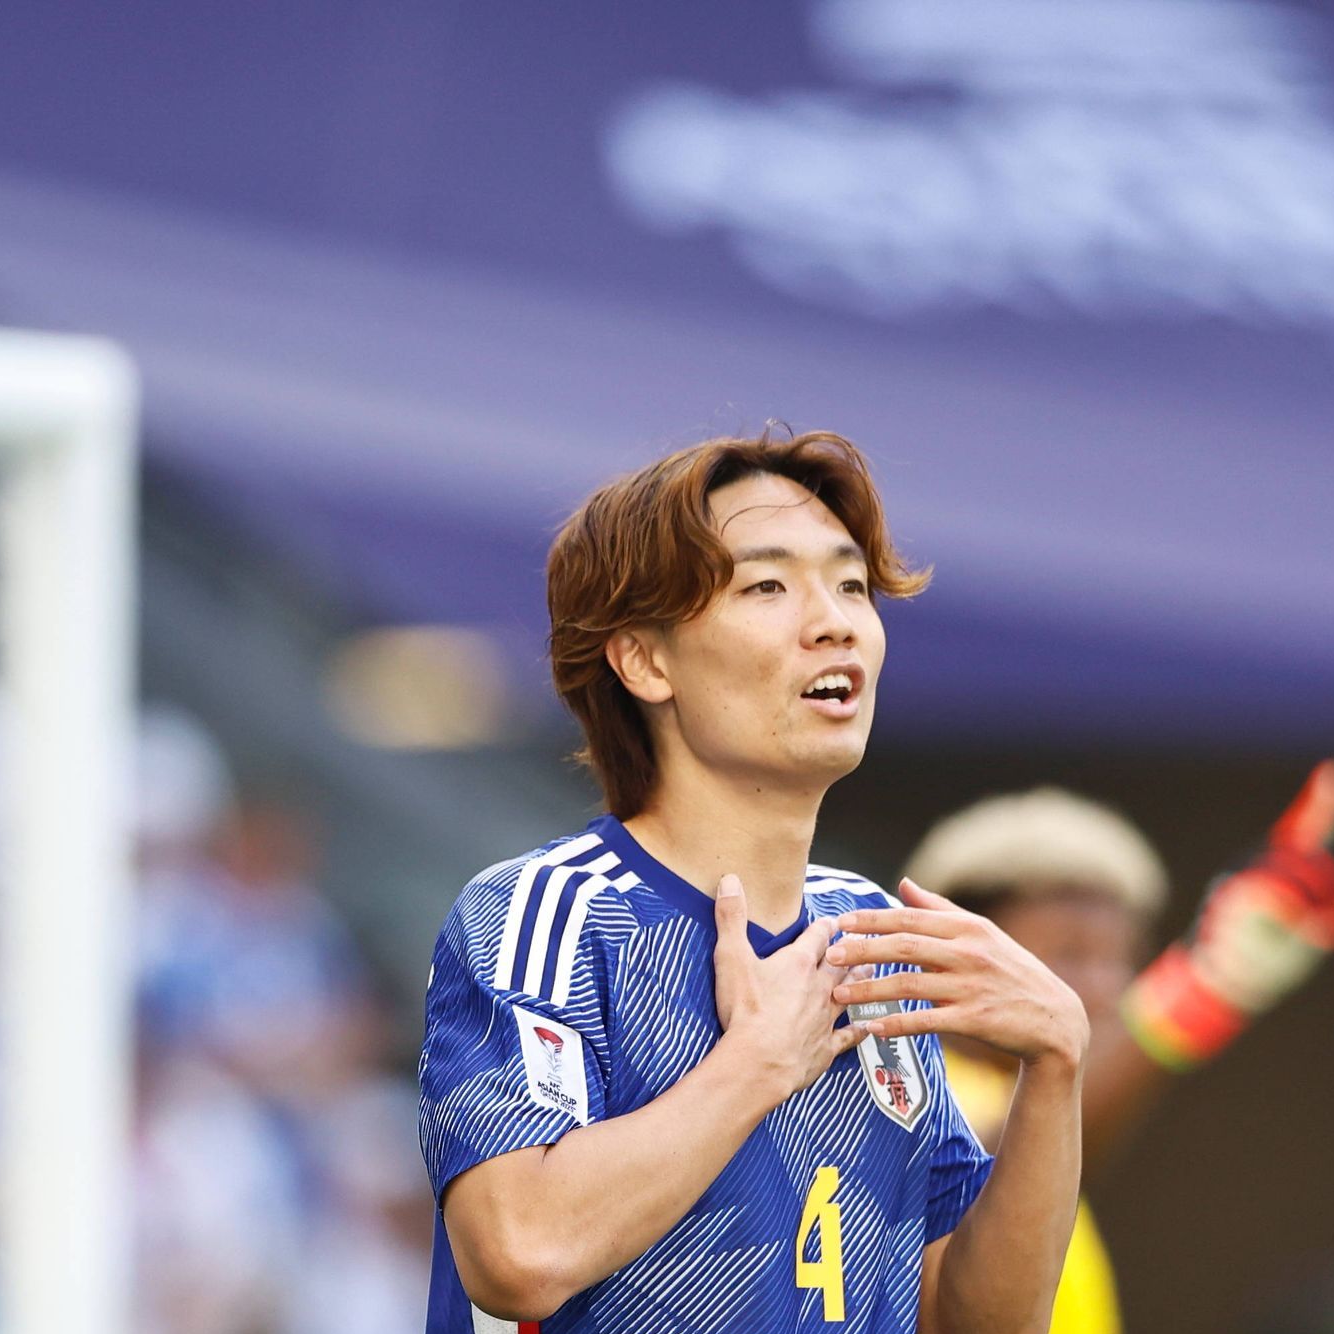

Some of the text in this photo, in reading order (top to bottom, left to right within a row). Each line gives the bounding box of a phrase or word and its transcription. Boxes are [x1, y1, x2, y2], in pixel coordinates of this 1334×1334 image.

[858, 1004, 887, 1015] JAPAN
[537, 1081, 577, 1105] ASIAN CUP
[795, 1165, 846, 1322] 4
